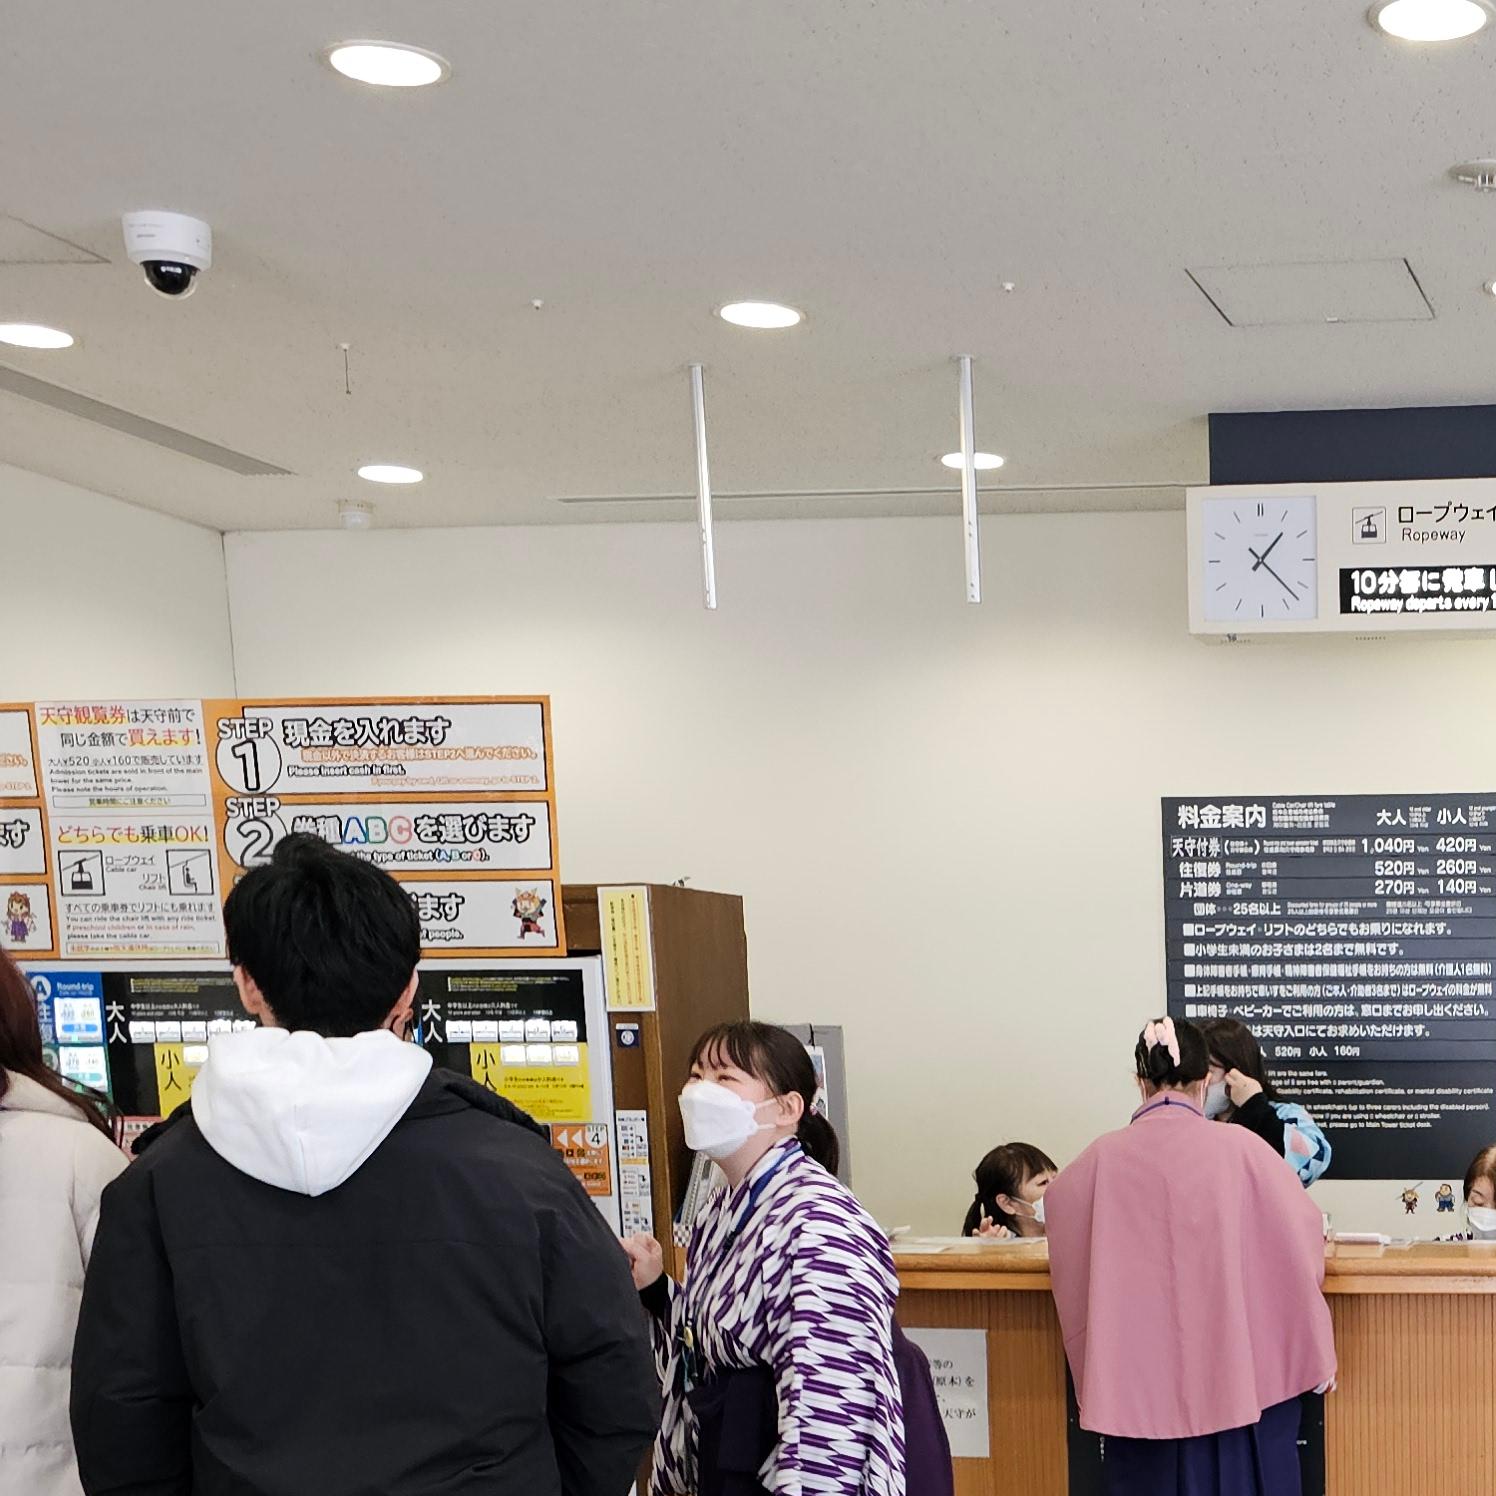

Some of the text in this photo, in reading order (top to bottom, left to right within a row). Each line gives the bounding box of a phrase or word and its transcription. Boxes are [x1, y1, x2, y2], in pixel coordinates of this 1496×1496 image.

[1401, 527, 1467, 545] Ropeway
[1351, 595, 1489, 614] Ropeway departs every
[40, 705, 195, 725] 天守観覧券は天守前で
[61, 727, 202, 748] 同じ金額で買えます!
[217, 717, 273, 739] STEP
[283, 716, 452, 748] 現金を入れます
[232, 740, 261, 792] 1
[288, 764, 320, 777] Please
[225, 797, 280, 818] STEP
[1178, 804, 1267, 829] 料金案内
[1376, 809, 1406, 825] 大人
[1437, 808, 1466, 825] 小人
[58, 825, 210, 845] どちらでも乗車OK!
[237, 820, 275, 868] 2
[373, 850, 433, 863] type of ticket
[1171, 837, 1221, 858] 天守付券
[1361, 837, 1415, 854] 1,040円
[1436, 837, 1477, 853] 420円
[105, 856, 155, 866] ロープウェイ
[1375, 860, 1415, 876] 520円
[1436, 859, 1477, 875] 260円
[143, 873, 166, 883] リフト
[1375, 880, 1415, 895] 270円
[1438, 879, 1477, 894] 140円
[429, 929, 464, 941] people.
[106, 1001, 128, 1044] 大人
[421, 999, 443, 1043] 大人
[1250, 1024, 1430, 1038] は天守入口にてお求めいただけます。
[161, 1049, 182, 1091] 小人
[476, 1049, 497, 1091] 小人
[591, 1133, 601, 1145] 4
